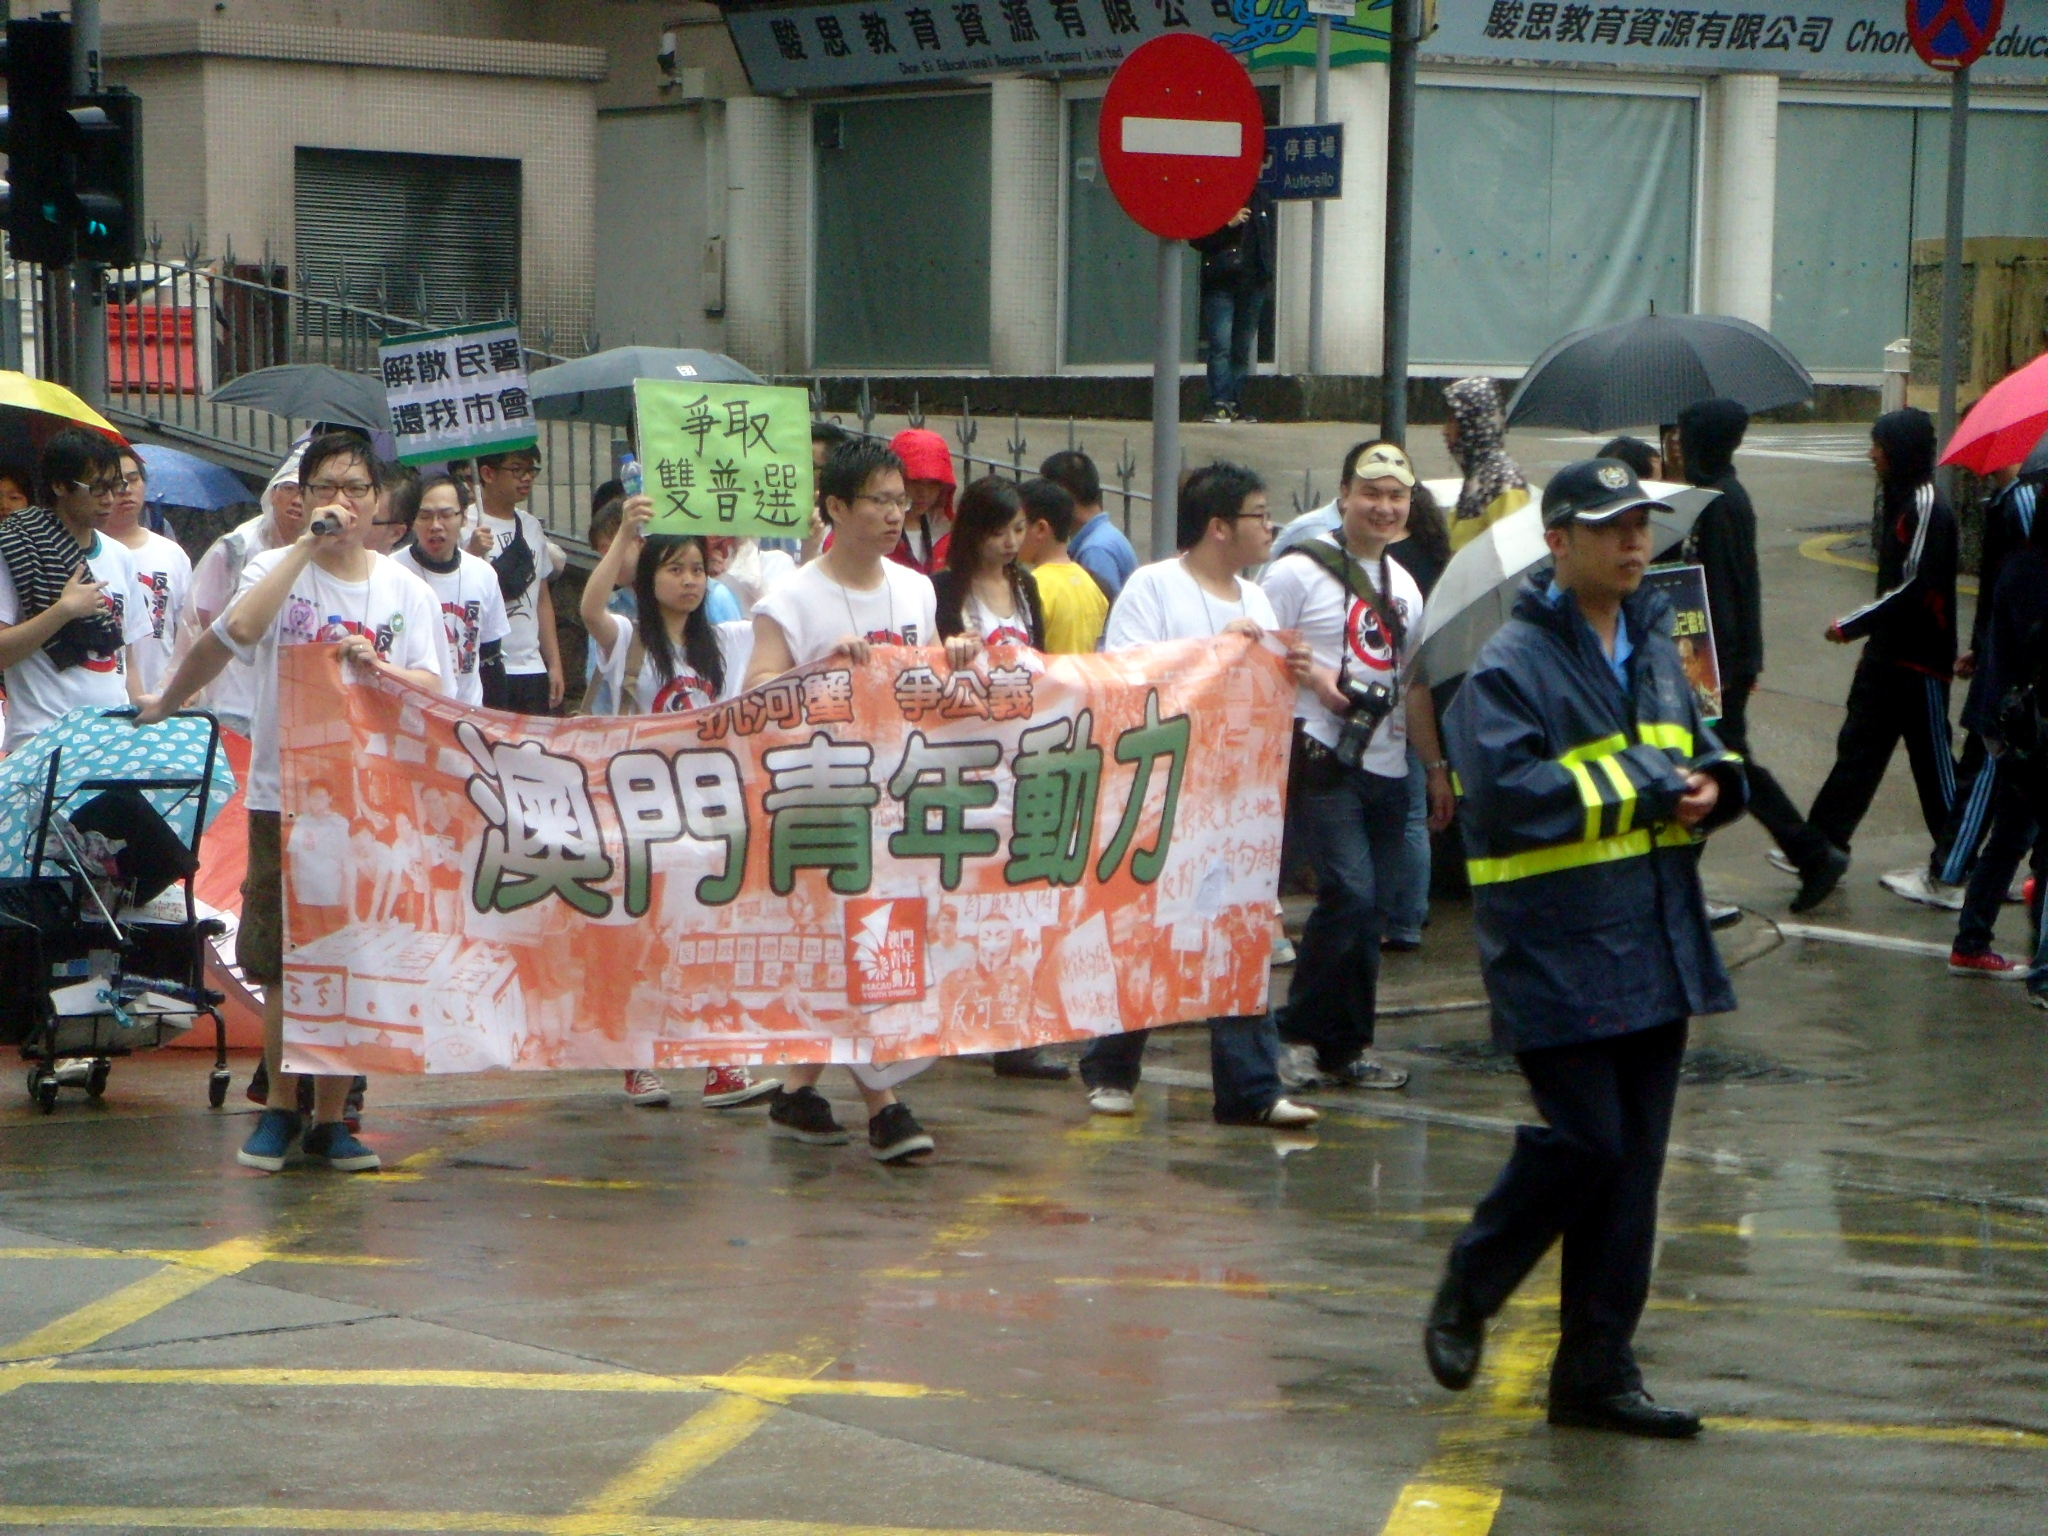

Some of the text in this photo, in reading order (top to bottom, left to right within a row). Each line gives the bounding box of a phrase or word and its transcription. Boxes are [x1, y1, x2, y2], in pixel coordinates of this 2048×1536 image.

[1483, 0, 1833, 53] 駿思教育資源有限公司
[1044, 49, 1081, 64] Company
[1284, 136, 1335, 162] 停車場
[1283, 171, 1335, 190] Auto-silo
[383, 337, 521, 389] 解散民署
[392, 387, 531, 438] 還我市會
[680, 393, 778, 459] 爭取
[655, 456, 801, 528] 雙普選
[454, 688, 1191, 918] 澳門青年動力
